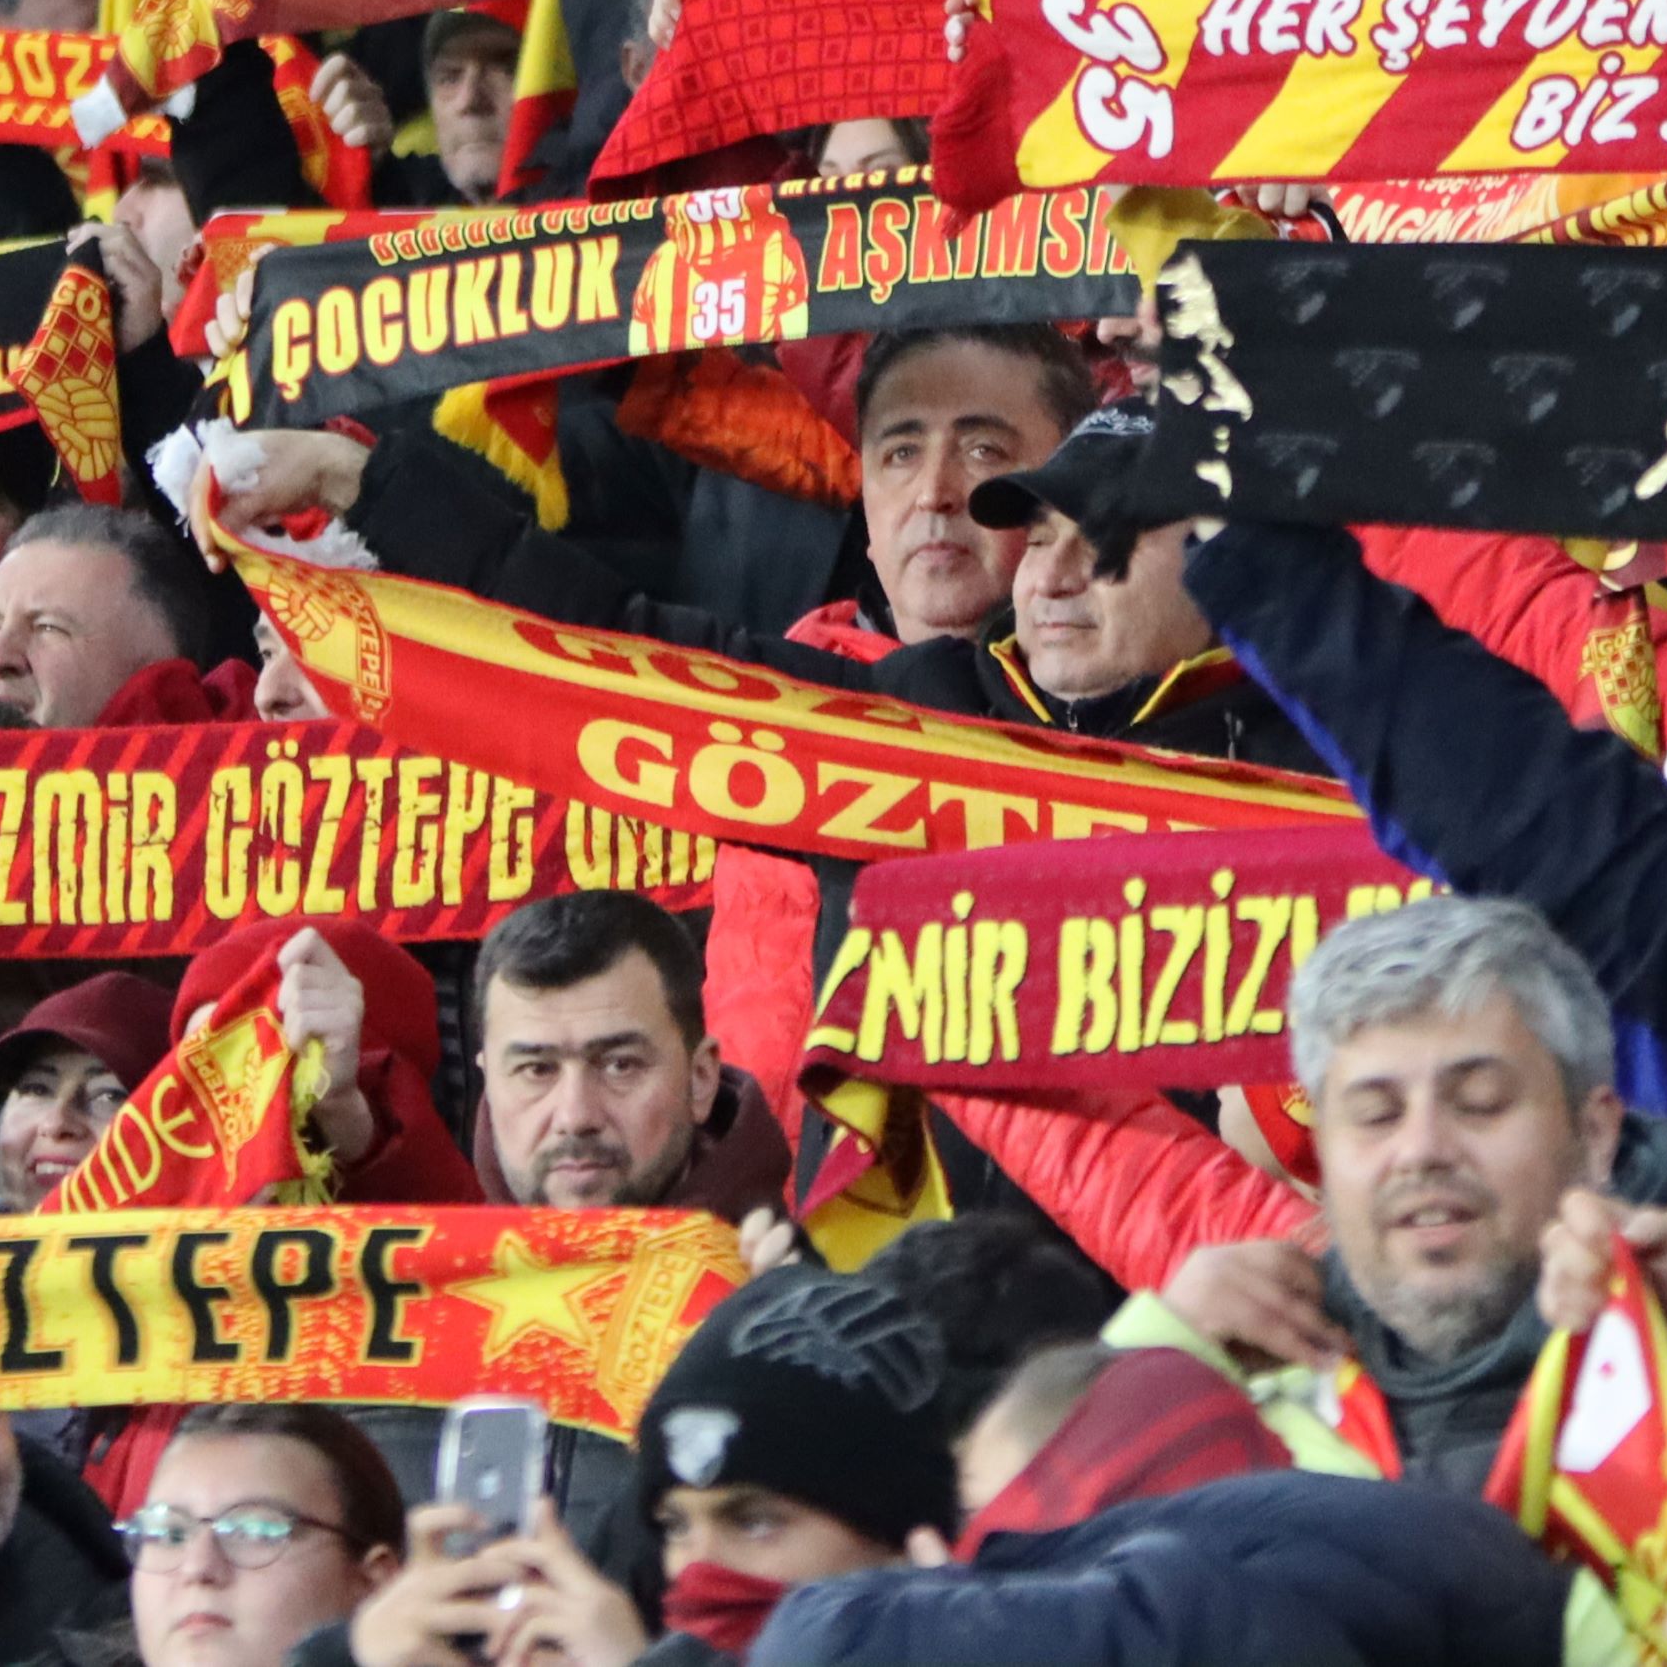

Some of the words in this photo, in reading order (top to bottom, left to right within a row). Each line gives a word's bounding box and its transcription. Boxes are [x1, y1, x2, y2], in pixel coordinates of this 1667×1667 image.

[1510, 51, 1660, 153] BİZ
[271, 234, 622, 402] ÇOCUKLUK
[691, 278, 747, 342] 35
[204, 739, 535, 921] GÖZTEPE
